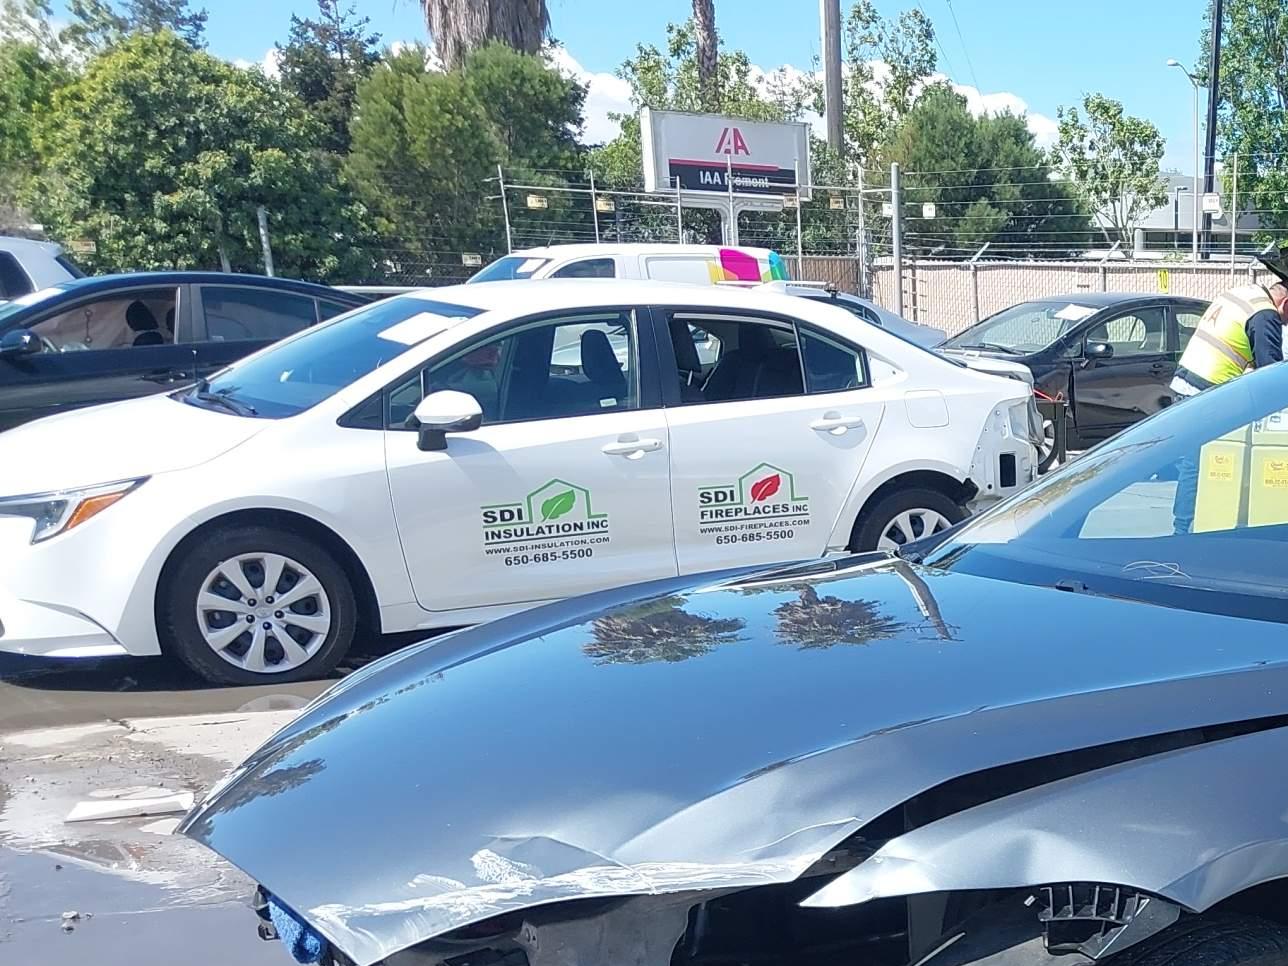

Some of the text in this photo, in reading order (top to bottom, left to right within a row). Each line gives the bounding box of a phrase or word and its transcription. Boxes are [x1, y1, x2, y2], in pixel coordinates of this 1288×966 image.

[700, 171, 721, 184] IAA
[1159, 269, 1168, 289] 10
[699, 489, 735, 504] SDI
[482, 507, 523, 524] SDI
[700, 503, 809, 520] FIREPLACES INC
[484, 519, 609, 541] INSULATION INC
[700, 519, 810, 534] WWW.SDI-FIREPLACES.COM
[485, 537, 610, 554] WWW.SDI-INSULATION.COM
[716, 529, 794, 545] 650-685-5500
[504, 547, 593, 567] 650-685-5500
